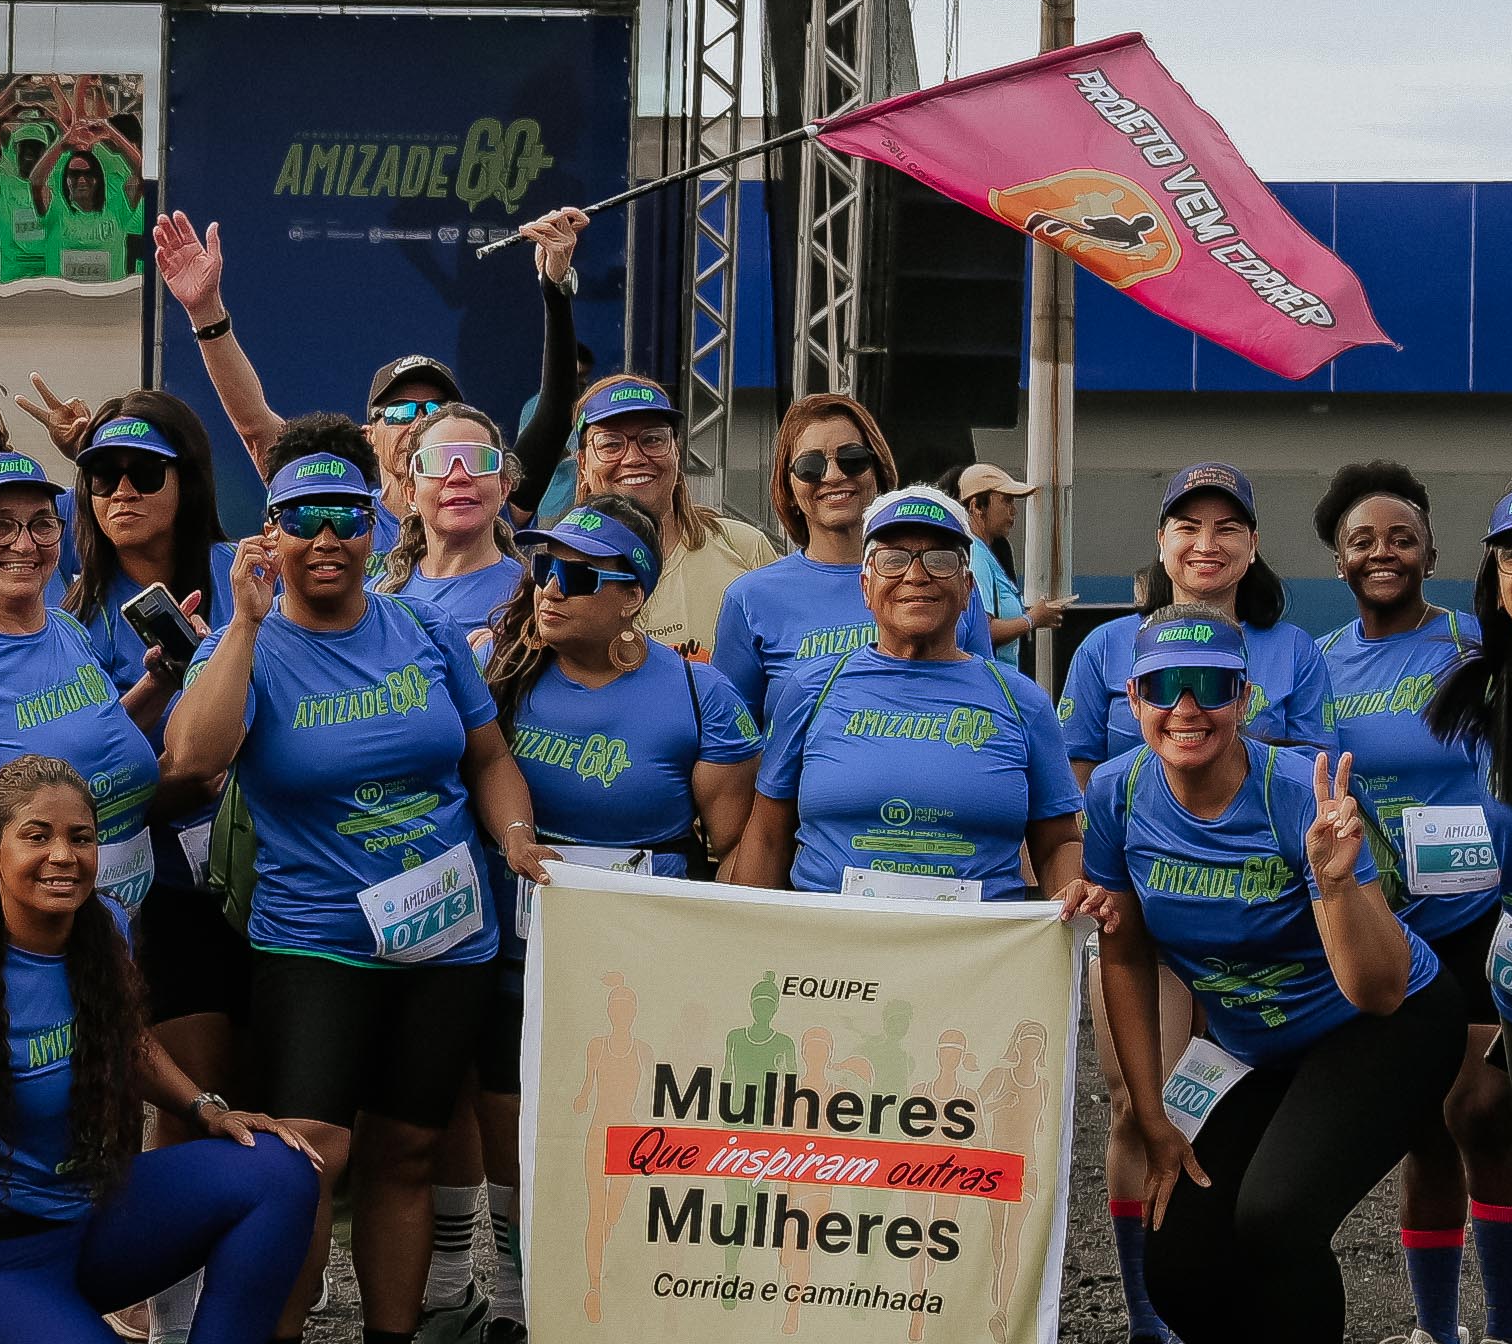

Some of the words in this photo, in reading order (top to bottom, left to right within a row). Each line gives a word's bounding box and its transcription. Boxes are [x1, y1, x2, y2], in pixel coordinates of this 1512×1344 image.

[1068, 68, 1186, 168] PROJETO
[274, 143, 458, 198] AMIZADE
[1161, 164, 1237, 246] VEM
[1209, 237, 1337, 330] CORRER
[16, 682, 90, 731] AMIZADE
[293, 686, 389, 730] AMIZADE
[843, 710, 946, 741] AMIZADE
[403, 880, 443, 913] AMIZADE
[1146, 860, 1240, 898] AMIZADE
[392, 892, 467, 950] 0713
[781, 974, 879, 1004] EQUIPE
[651, 1063, 977, 1141] Mulheres
[629, 1127, 697, 1172] Que
[705, 1135, 880, 1189] inspiram
[885, 1154, 1003, 1195] outras
[646, 1186, 962, 1264] Mulheres
[653, 1272, 755, 1303] Corrida
[760, 1284, 778, 1301] e
[783, 1280, 944, 1316] caminhada
